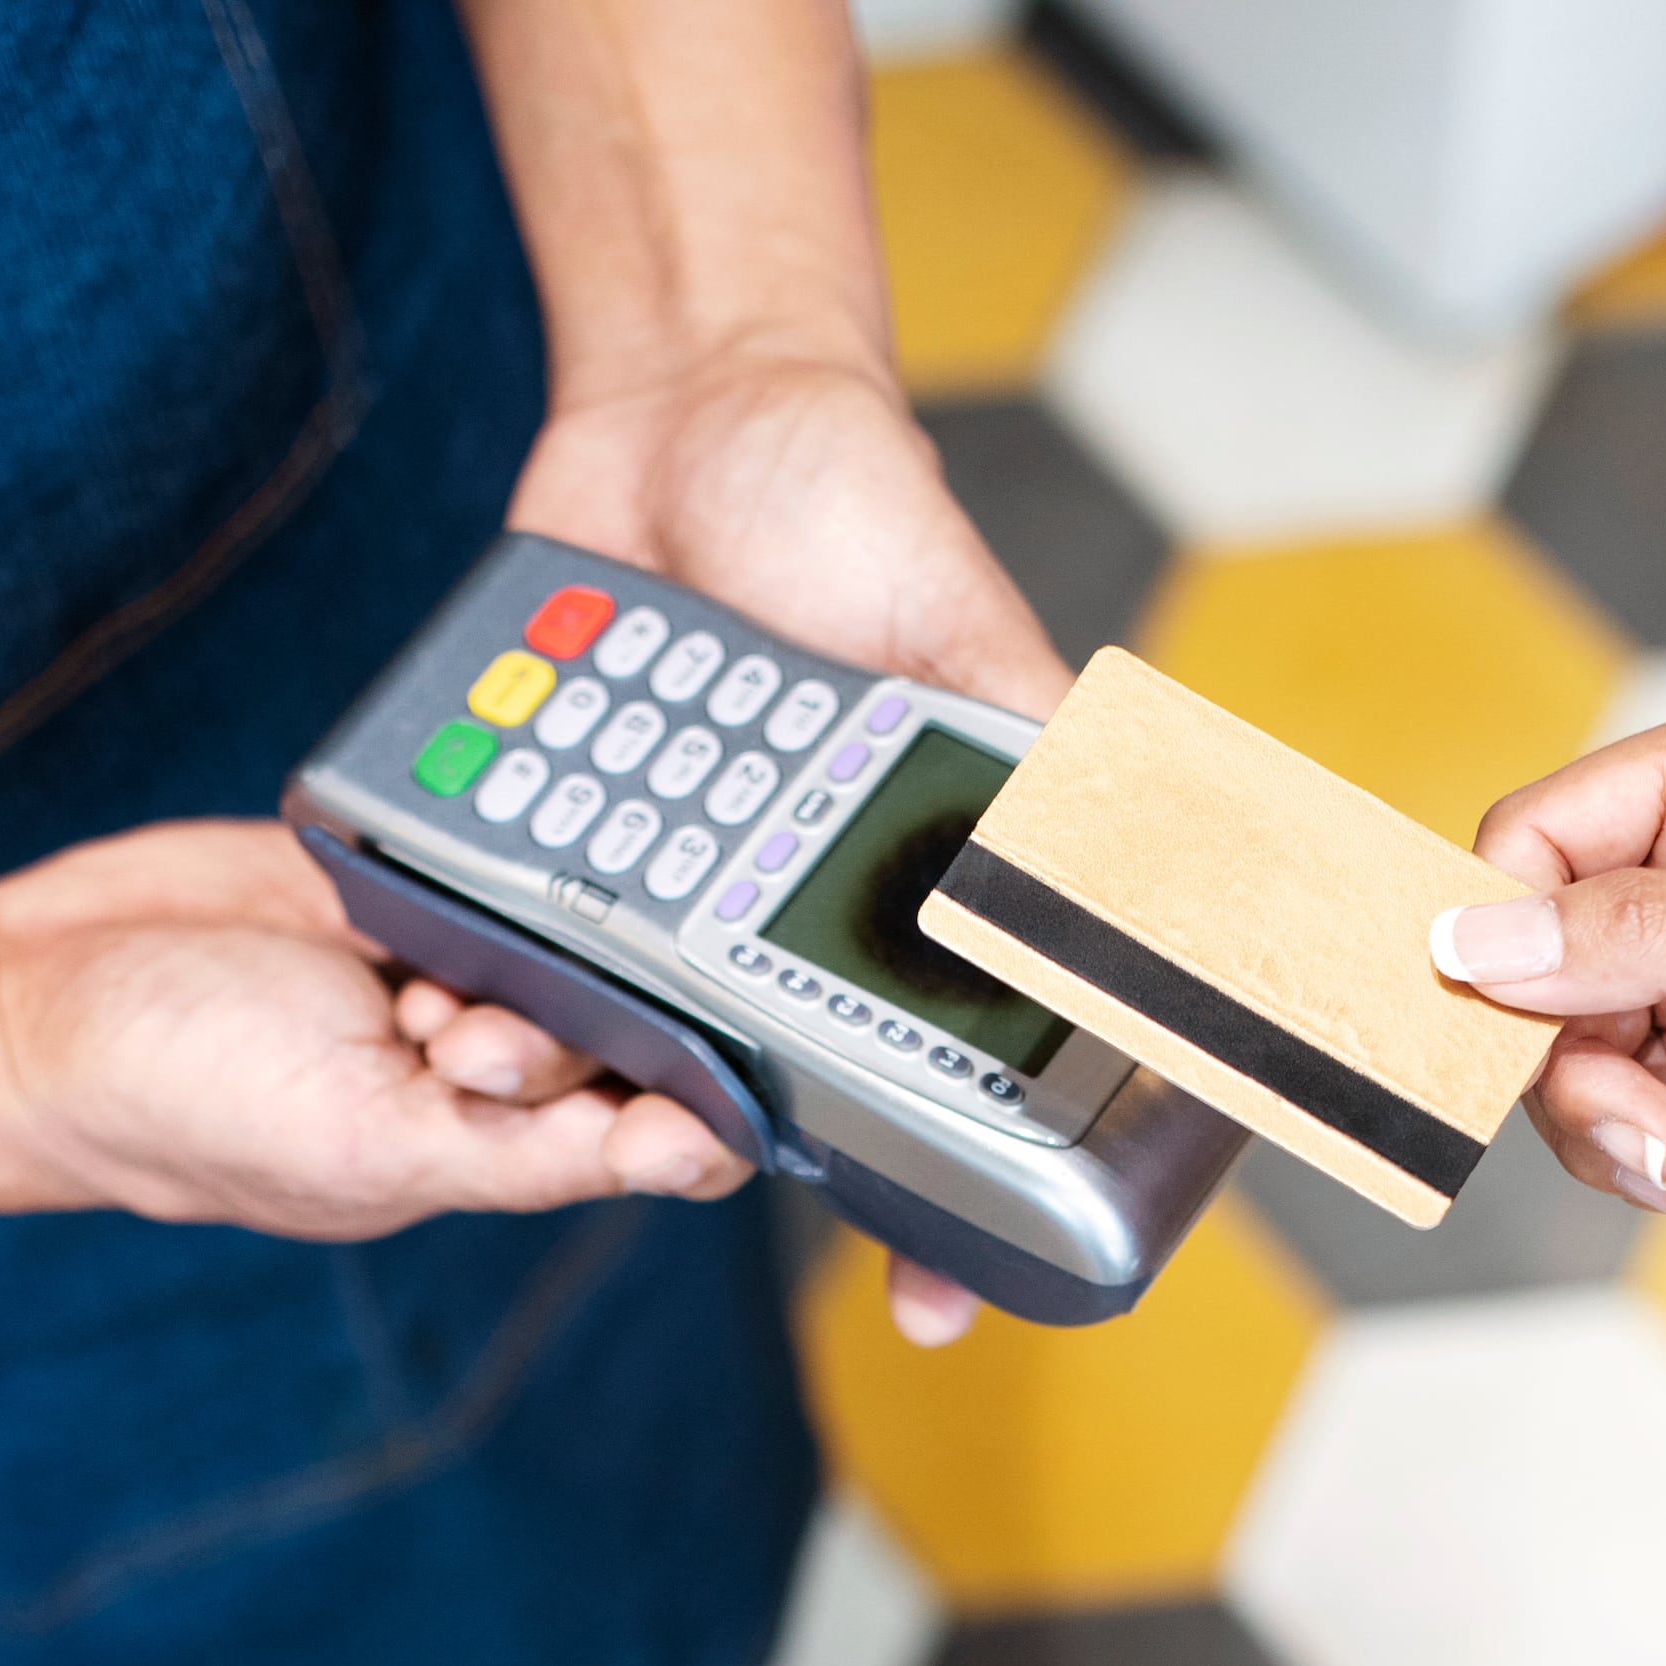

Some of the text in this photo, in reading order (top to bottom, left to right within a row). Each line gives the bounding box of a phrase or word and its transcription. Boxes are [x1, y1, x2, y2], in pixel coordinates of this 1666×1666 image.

[741, 668, 762, 685] 4
[569, 690, 594, 709] 0
[682, 741, 709, 758] 5
[737, 764, 766, 784] 2
[567, 785, 593, 804] 9
[623, 812, 649, 831] 6
[680, 836, 708, 856] 3
[886, 1023, 910, 1042] F2
[938, 1050, 961, 1068] F1
[990, 1075, 1013, 1095] F0
